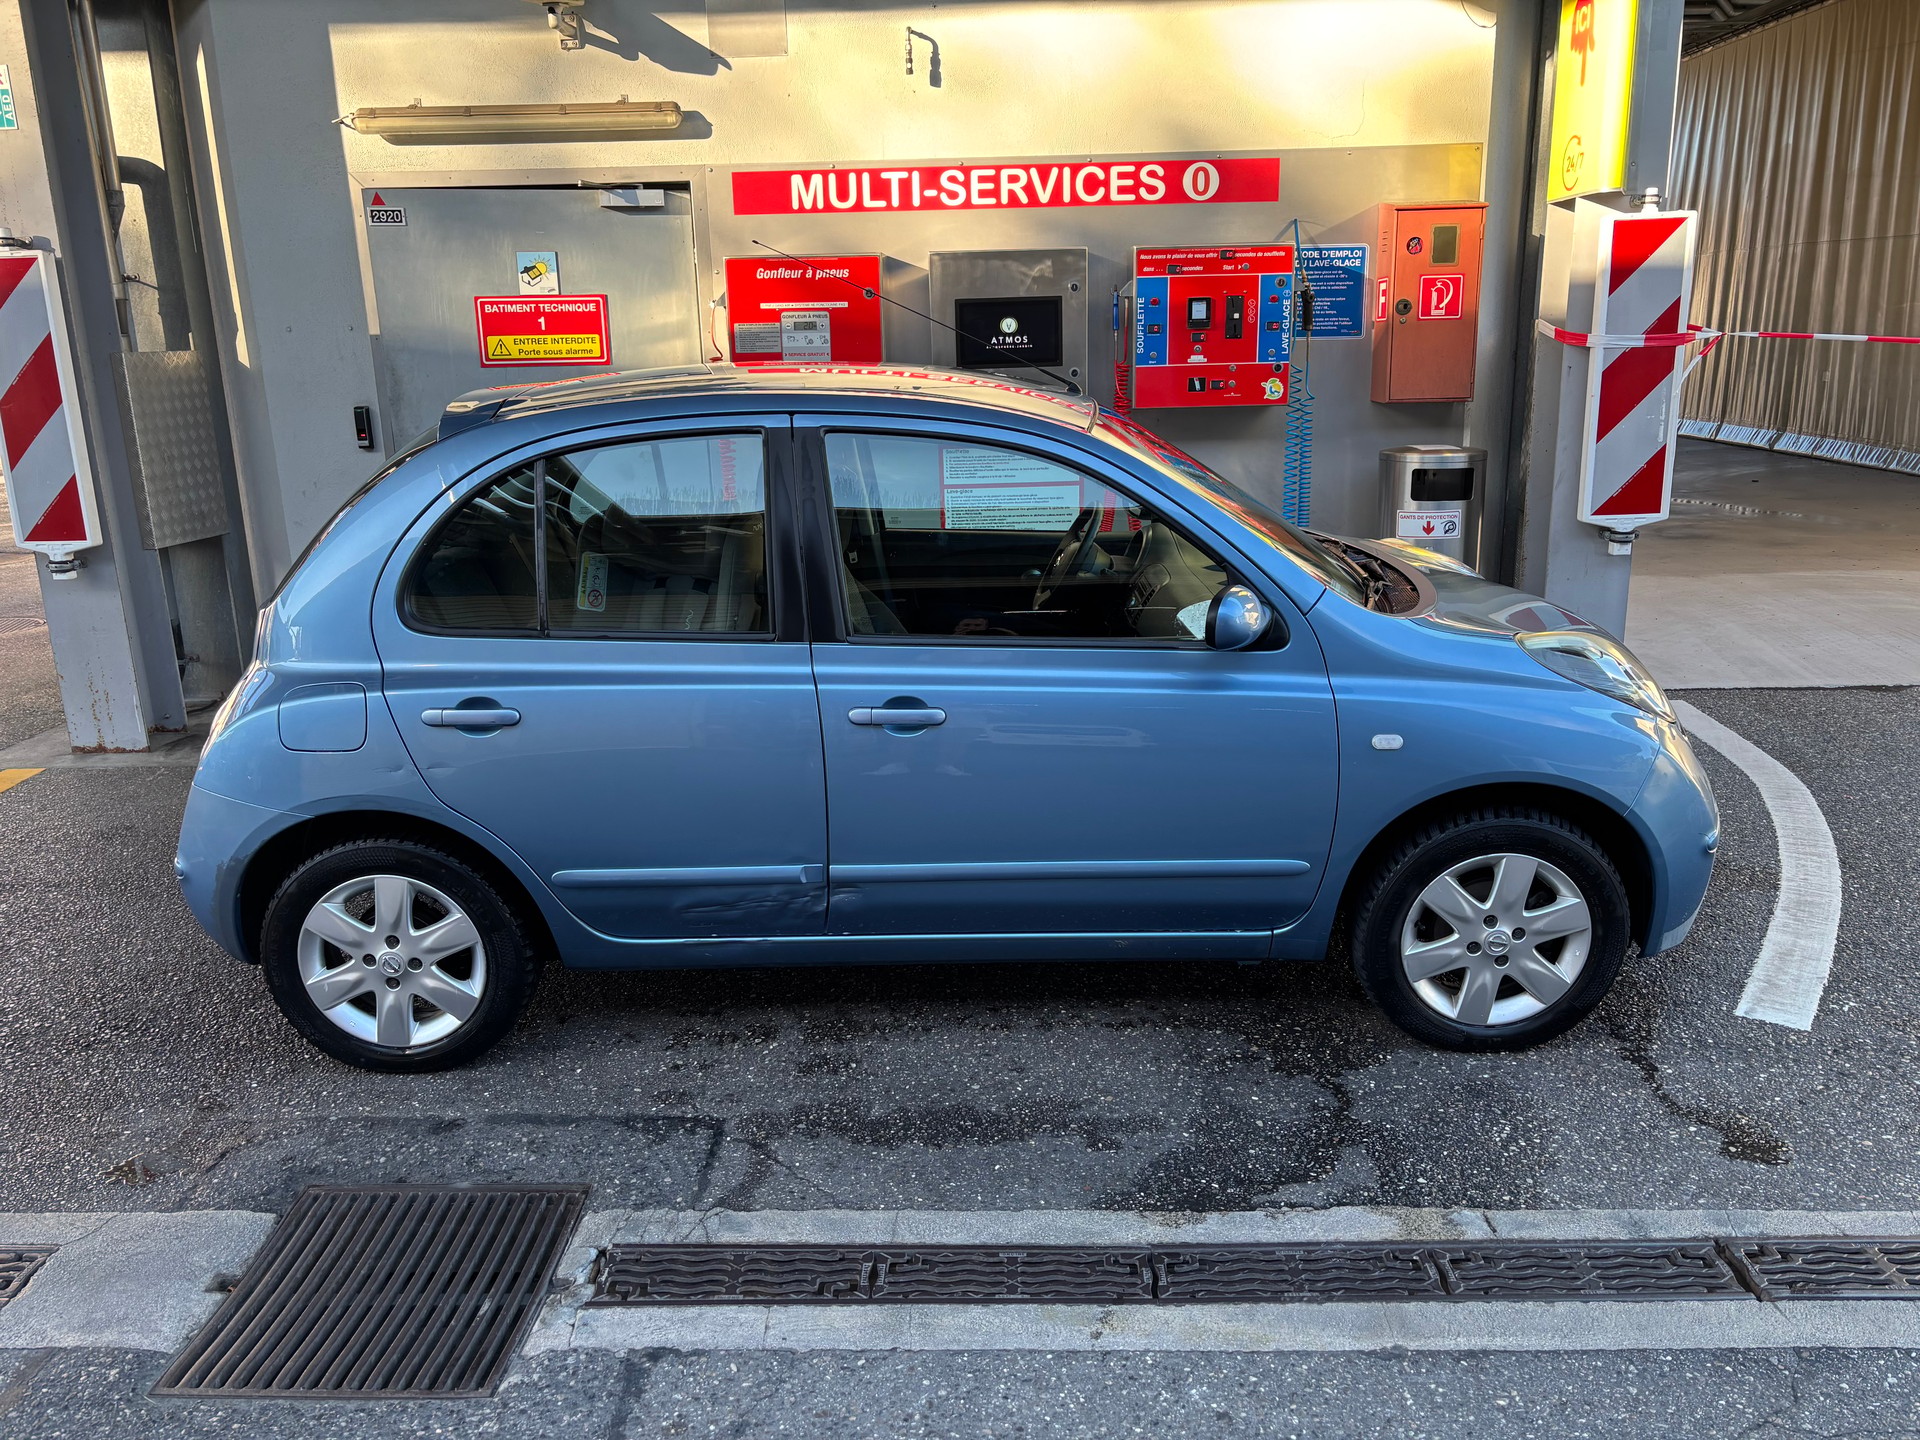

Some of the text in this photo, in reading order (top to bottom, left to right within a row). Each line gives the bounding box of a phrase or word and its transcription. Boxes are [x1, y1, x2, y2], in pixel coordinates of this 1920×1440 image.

[1576, 4, 1590, 34] ICI
[2, 94, 14, 120] AED
[1566, 152, 1584, 172] 24/7
[790, 164, 1165, 210] MULTI-SERVICES
[372, 211, 401, 222] 2920
[1310, 259, 1361, 267] LAVE-GLACE
[756, 266, 849, 280] Gonfleur à pneus
[1379, 282, 1387, 317] F
[485, 303, 596, 313] BATIMENT TECHNIQUE
[538, 316, 546, 330] 1
[1282, 299, 1290, 354] LAVE-GLACE
[551, 336, 596, 344] INTERDITE
[991, 336, 1028, 344] ATMOS
[518, 348, 540, 356] Porte
